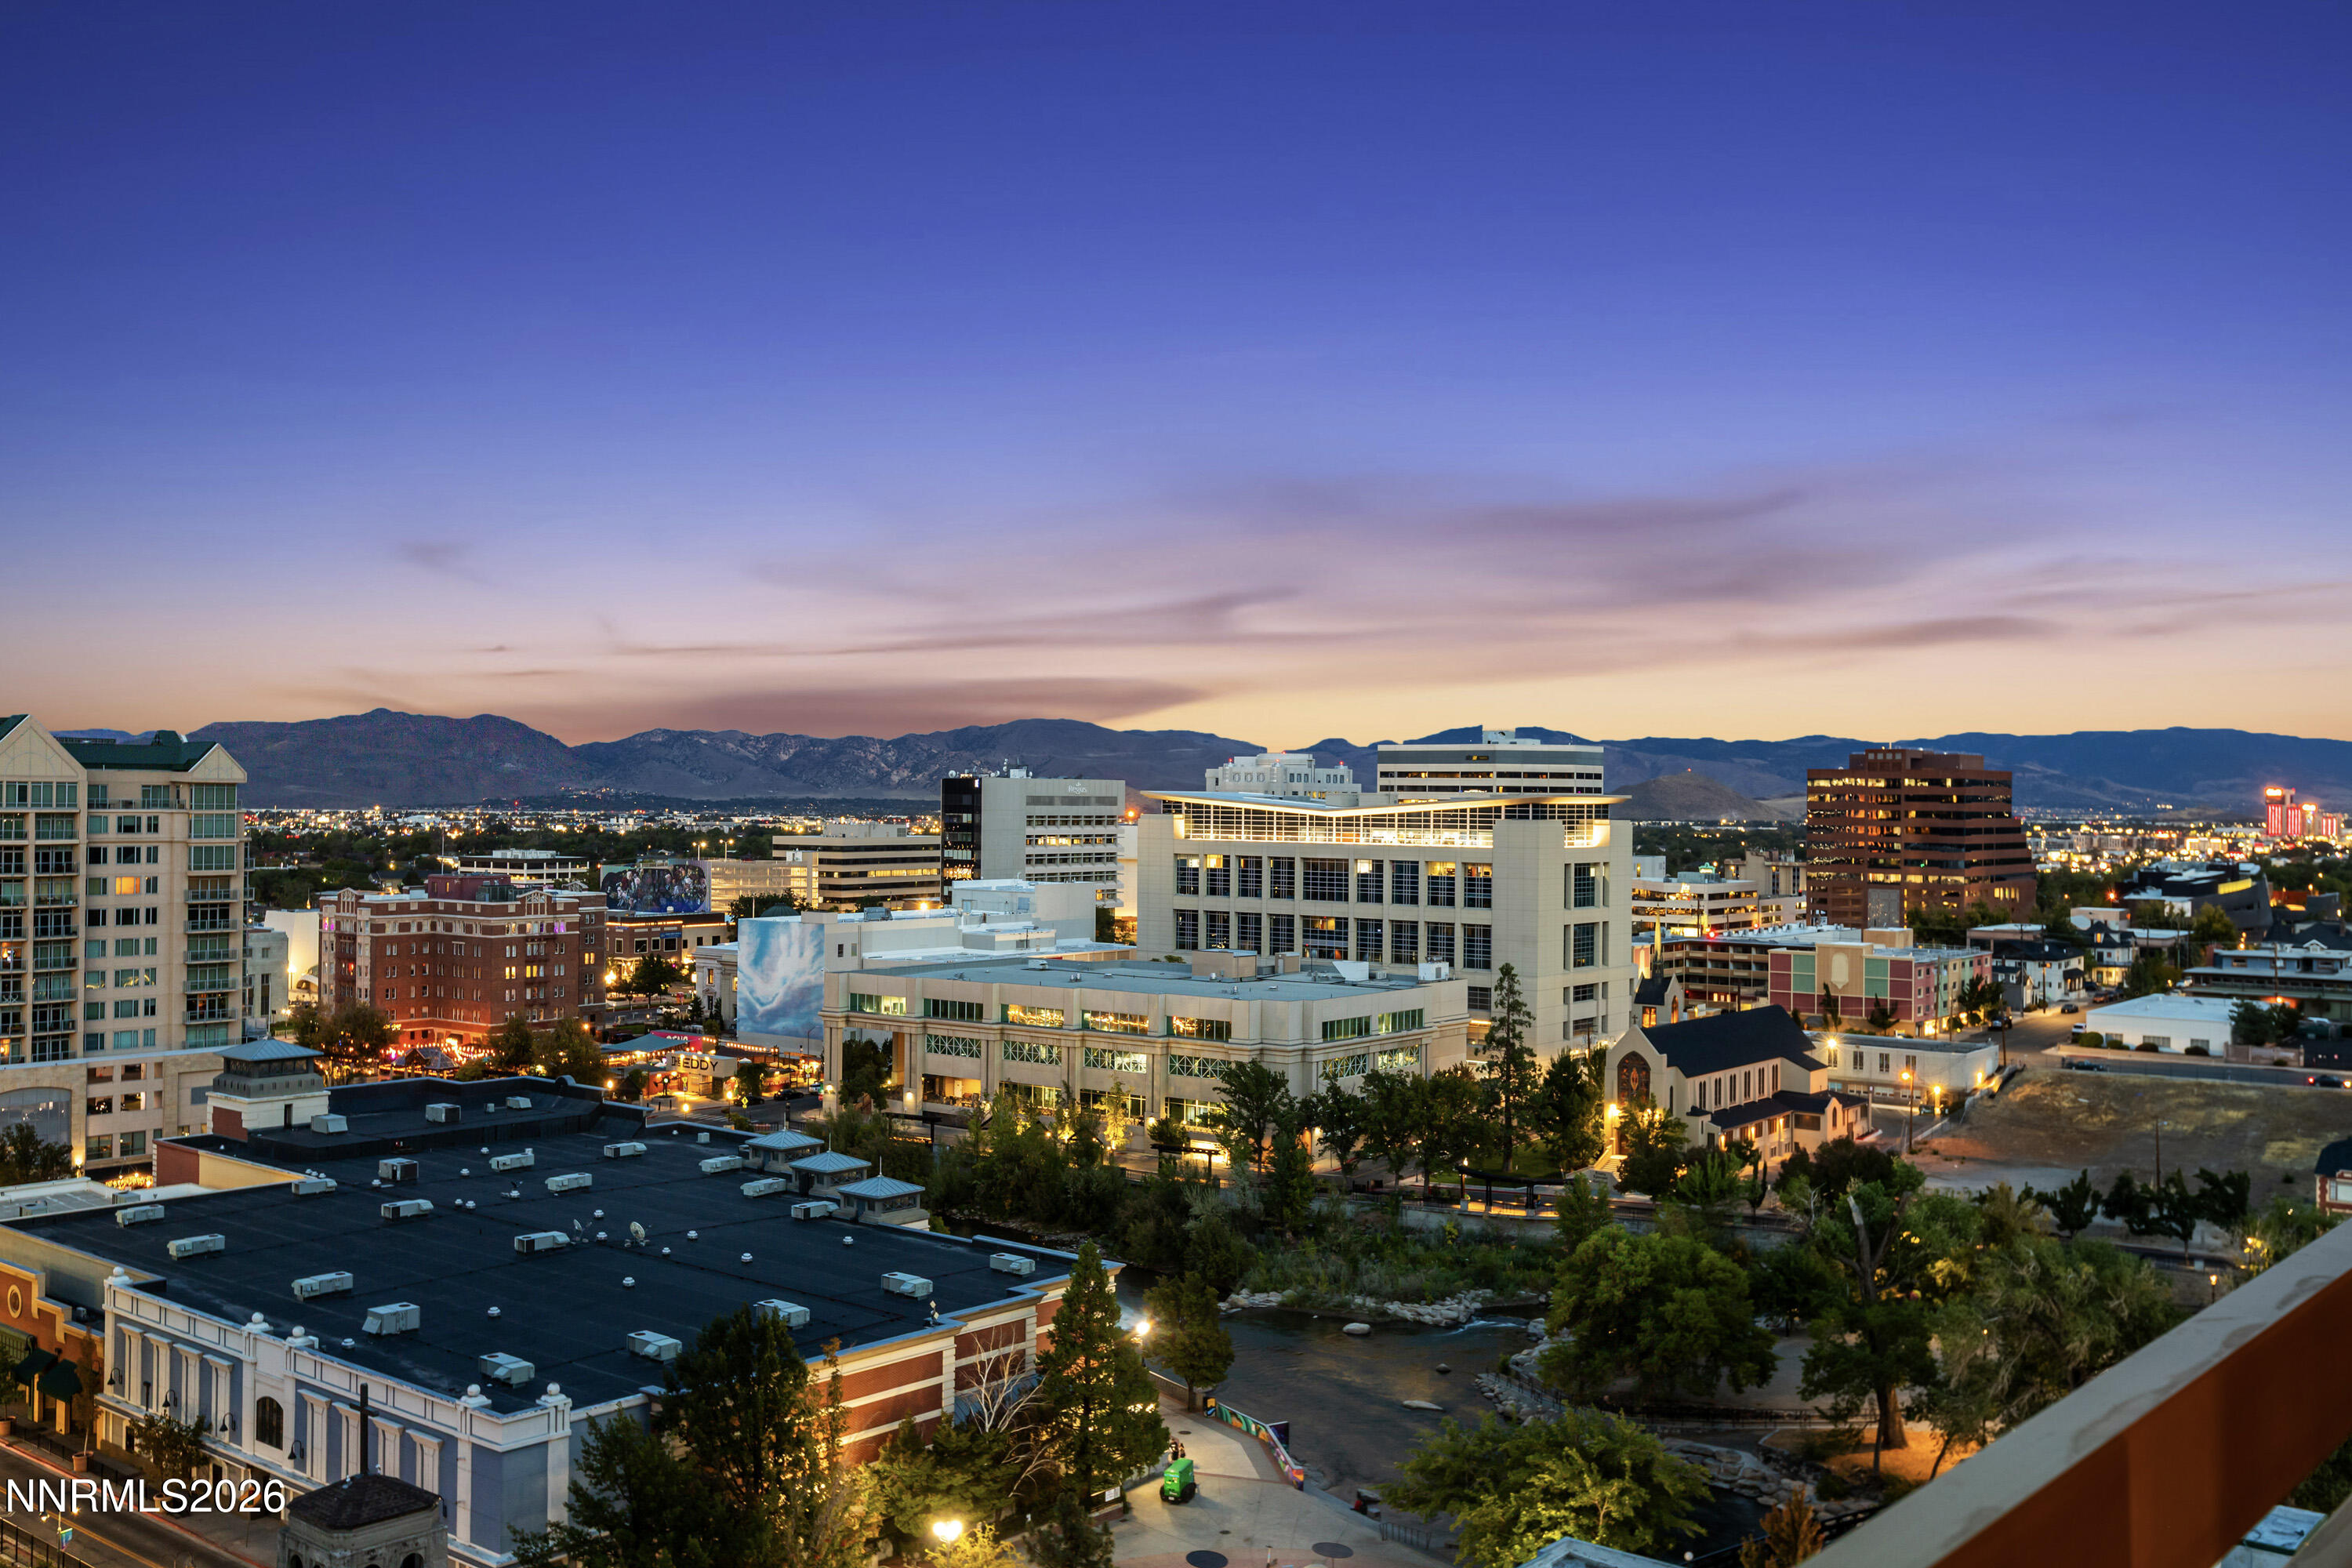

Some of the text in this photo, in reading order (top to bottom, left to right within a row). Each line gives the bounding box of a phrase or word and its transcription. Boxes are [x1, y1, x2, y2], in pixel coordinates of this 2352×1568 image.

[1068, 784, 1087, 795] Regus
[671, 1056, 718, 1072] THE EDDY
